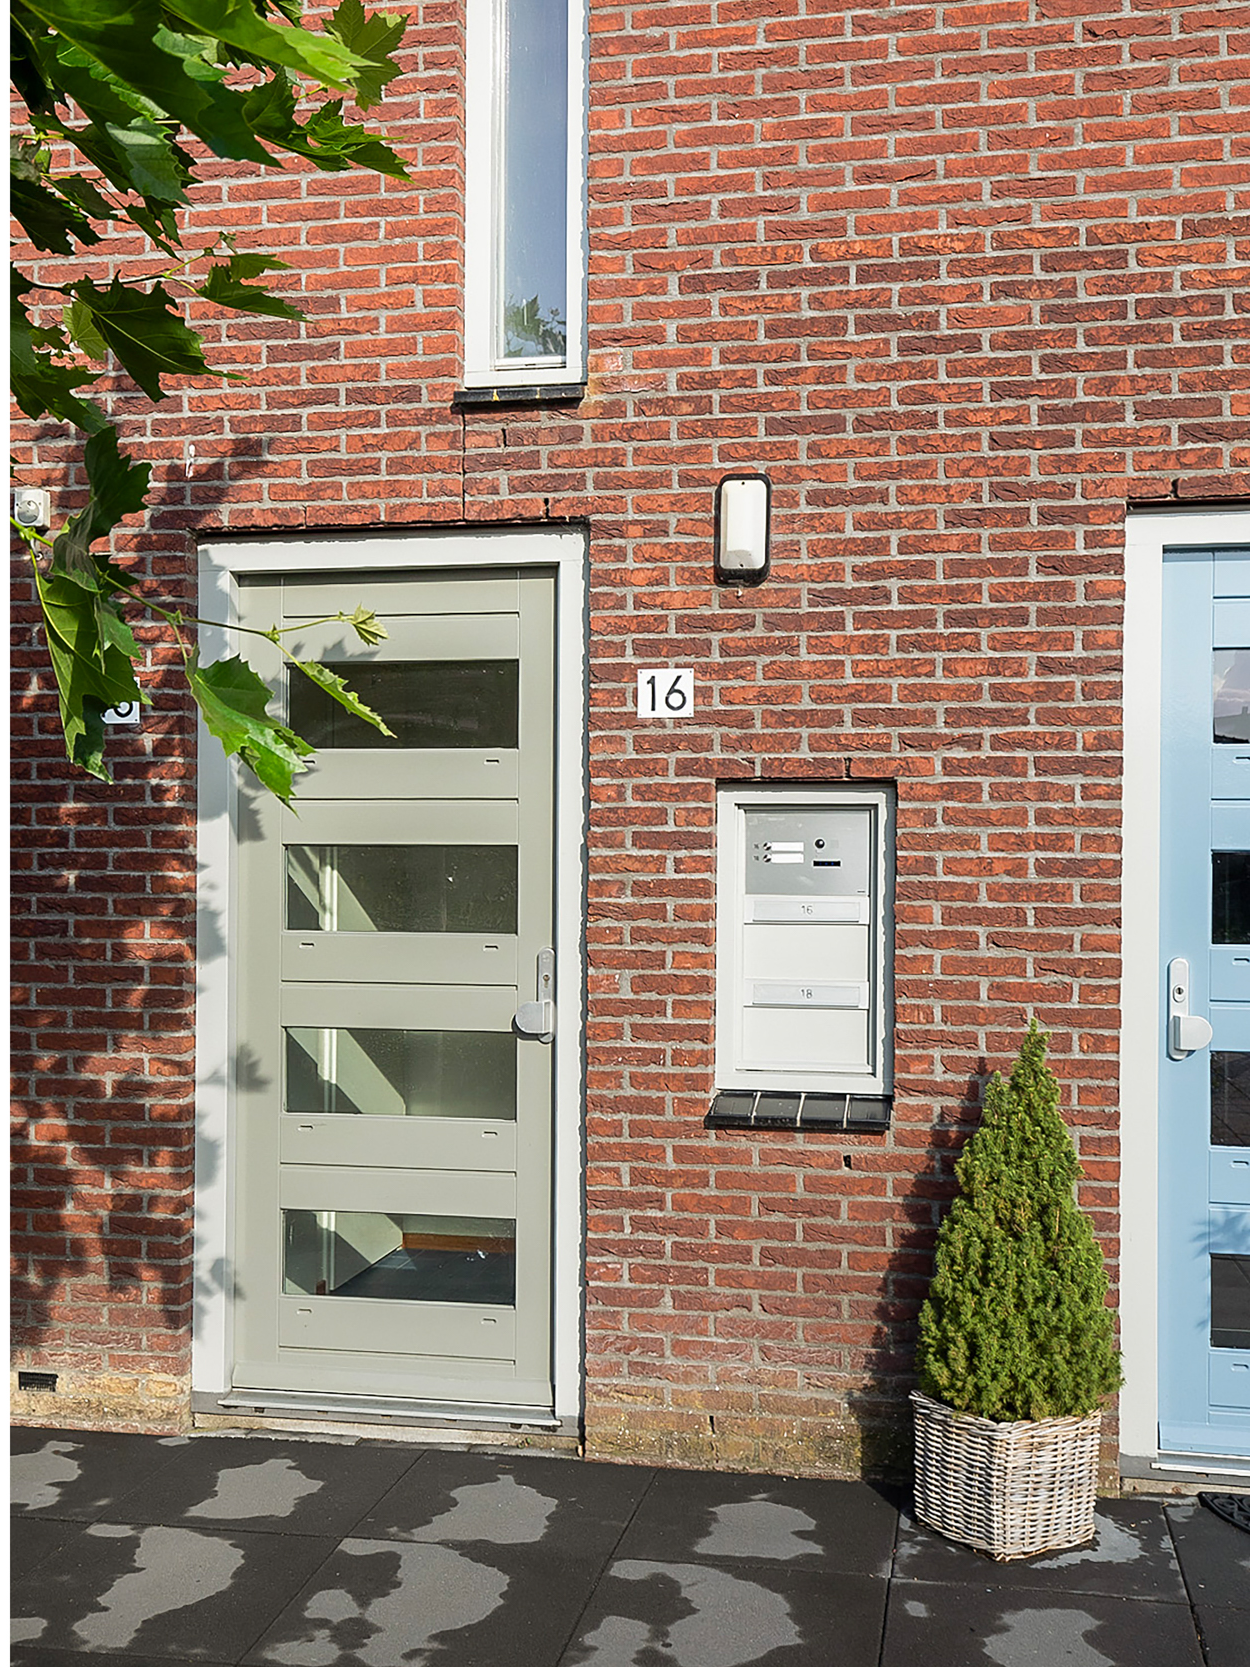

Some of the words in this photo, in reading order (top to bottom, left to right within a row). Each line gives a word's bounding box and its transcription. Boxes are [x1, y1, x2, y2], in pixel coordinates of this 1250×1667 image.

[646, 674, 687, 712] 16
[801, 905, 813, 915] 16
[801, 988, 813, 999] 18
